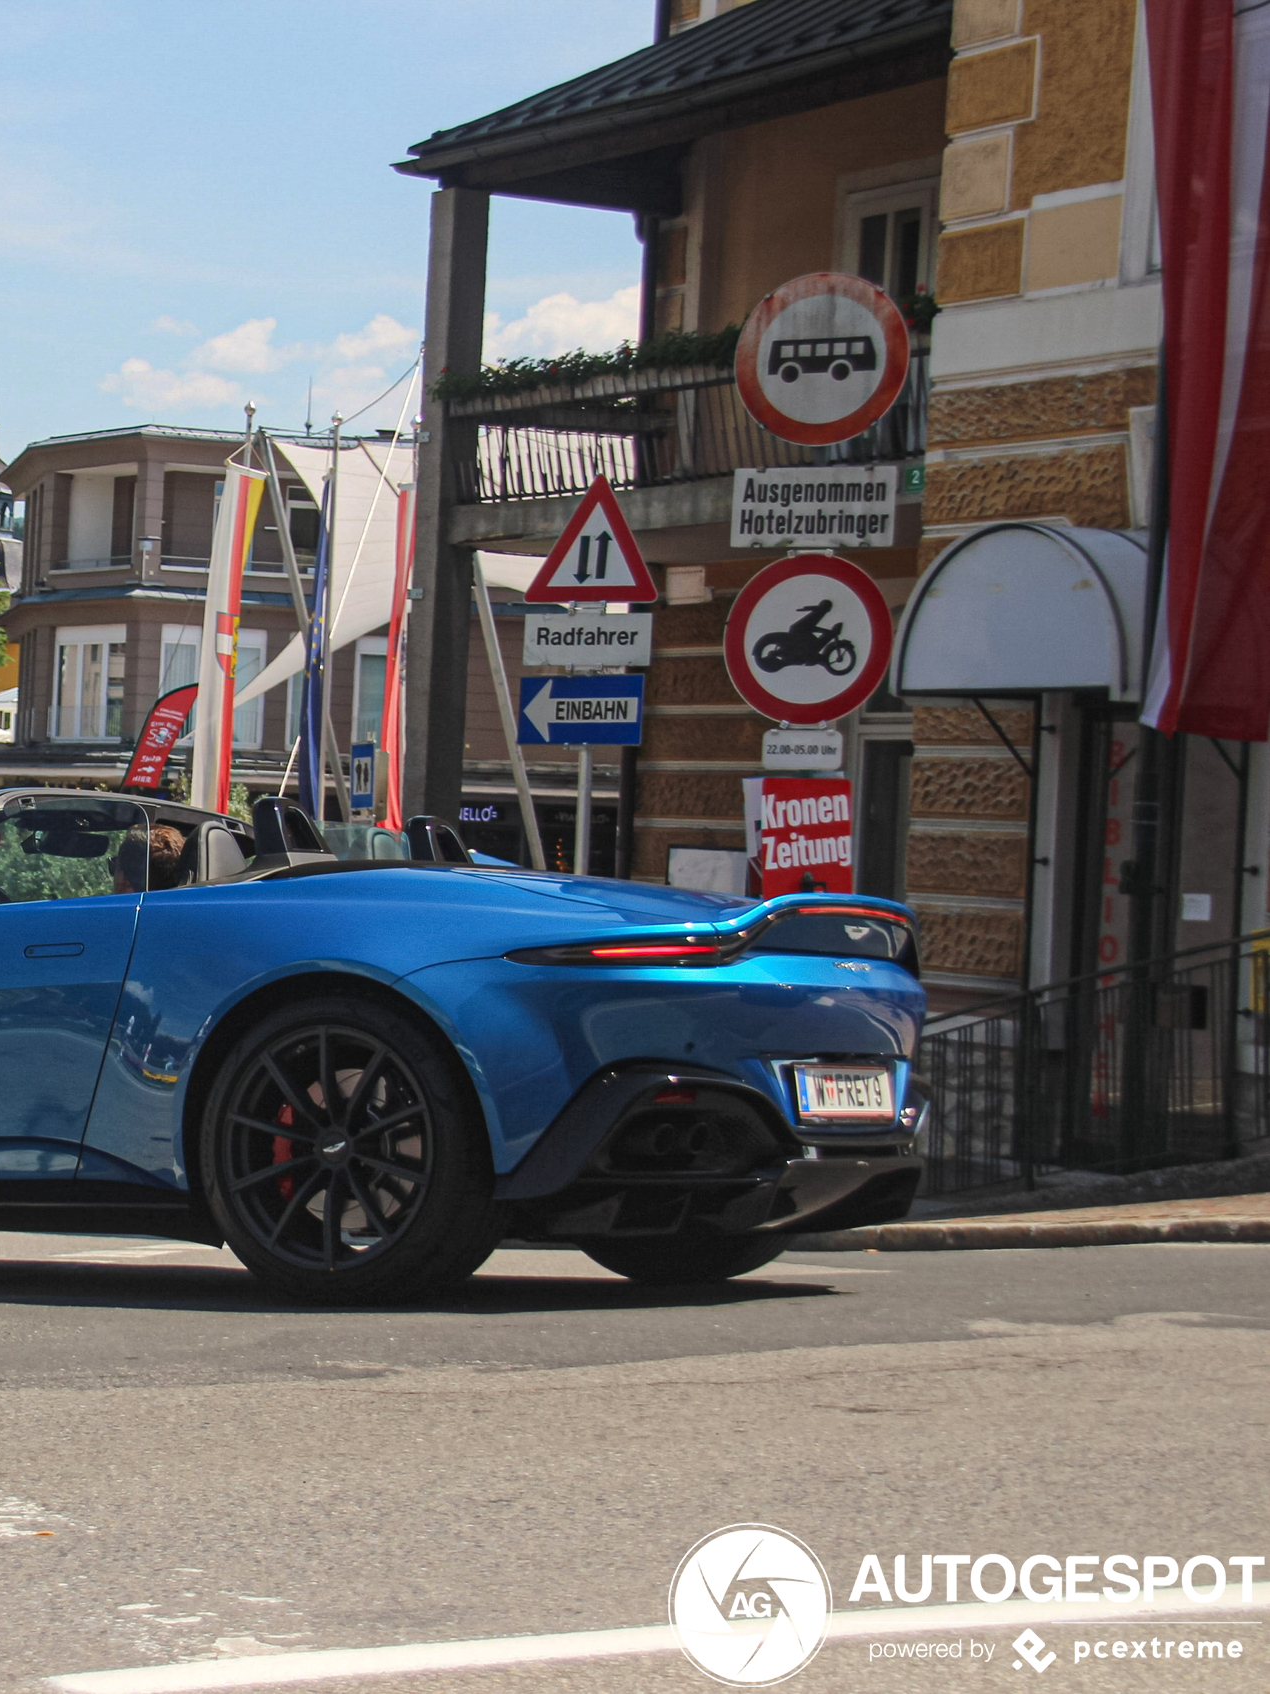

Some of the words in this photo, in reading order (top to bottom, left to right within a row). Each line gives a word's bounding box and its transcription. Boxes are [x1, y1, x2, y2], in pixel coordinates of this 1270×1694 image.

[742, 477, 886, 508] Ausgenommen
[739, 509, 890, 539] Hotelzubringer
[536, 626, 638, 646] Radfahrer
[555, 700, 629, 720] EINBAHN
[766, 745, 819, 755] 22.00-05.00
[821, 745, 837, 755] Uhr
[761, 793, 849, 830] Kronen
[762, 832, 852, 870] Zeitung
